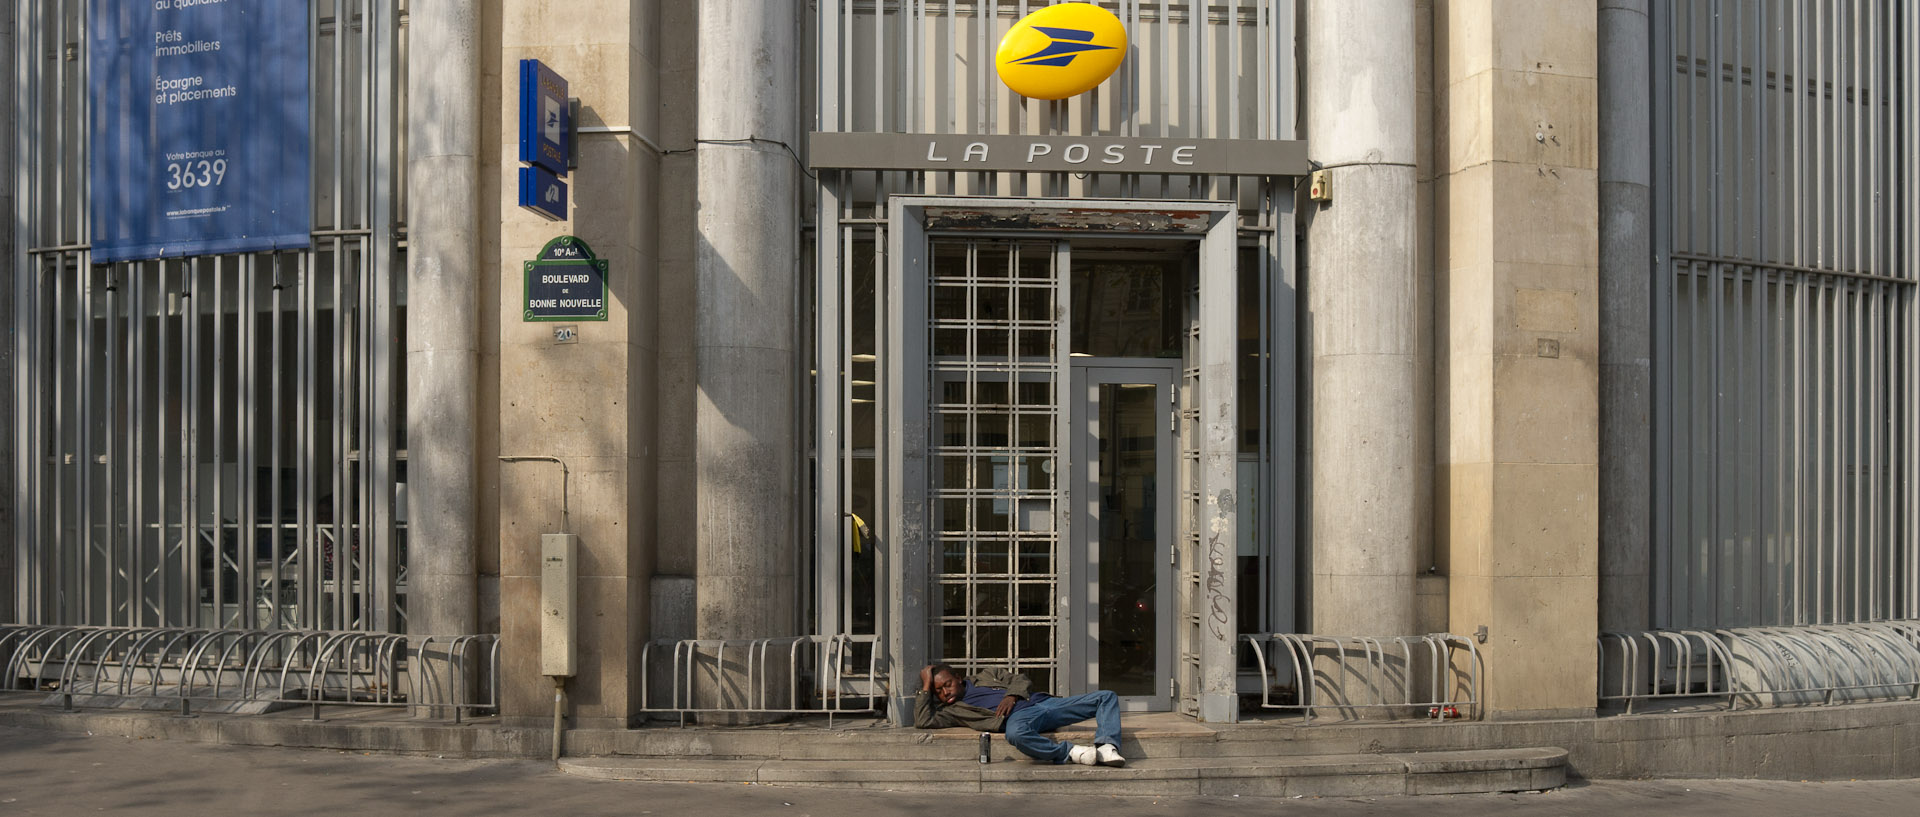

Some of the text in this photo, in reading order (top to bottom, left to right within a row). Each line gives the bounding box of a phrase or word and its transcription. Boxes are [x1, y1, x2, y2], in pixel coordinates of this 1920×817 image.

[156, 0, 170, 10] au
[156, 31, 182, 43] Prêts
[156, 41, 221, 57] immobiliers
[156, 76, 203, 92] Épargne
[156, 85, 237, 105] et placements
[166, 153, 184, 161] Votre
[186, 150, 214, 158] banque
[543, 143, 562, 164] POSTALE
[927, 141, 1198, 166] LA POSTE
[542, 275, 590, 284] BOULEVARD
[530, 299, 602, 308] BONNE NOUVELLE
[557, 328, 572, 340] 20
